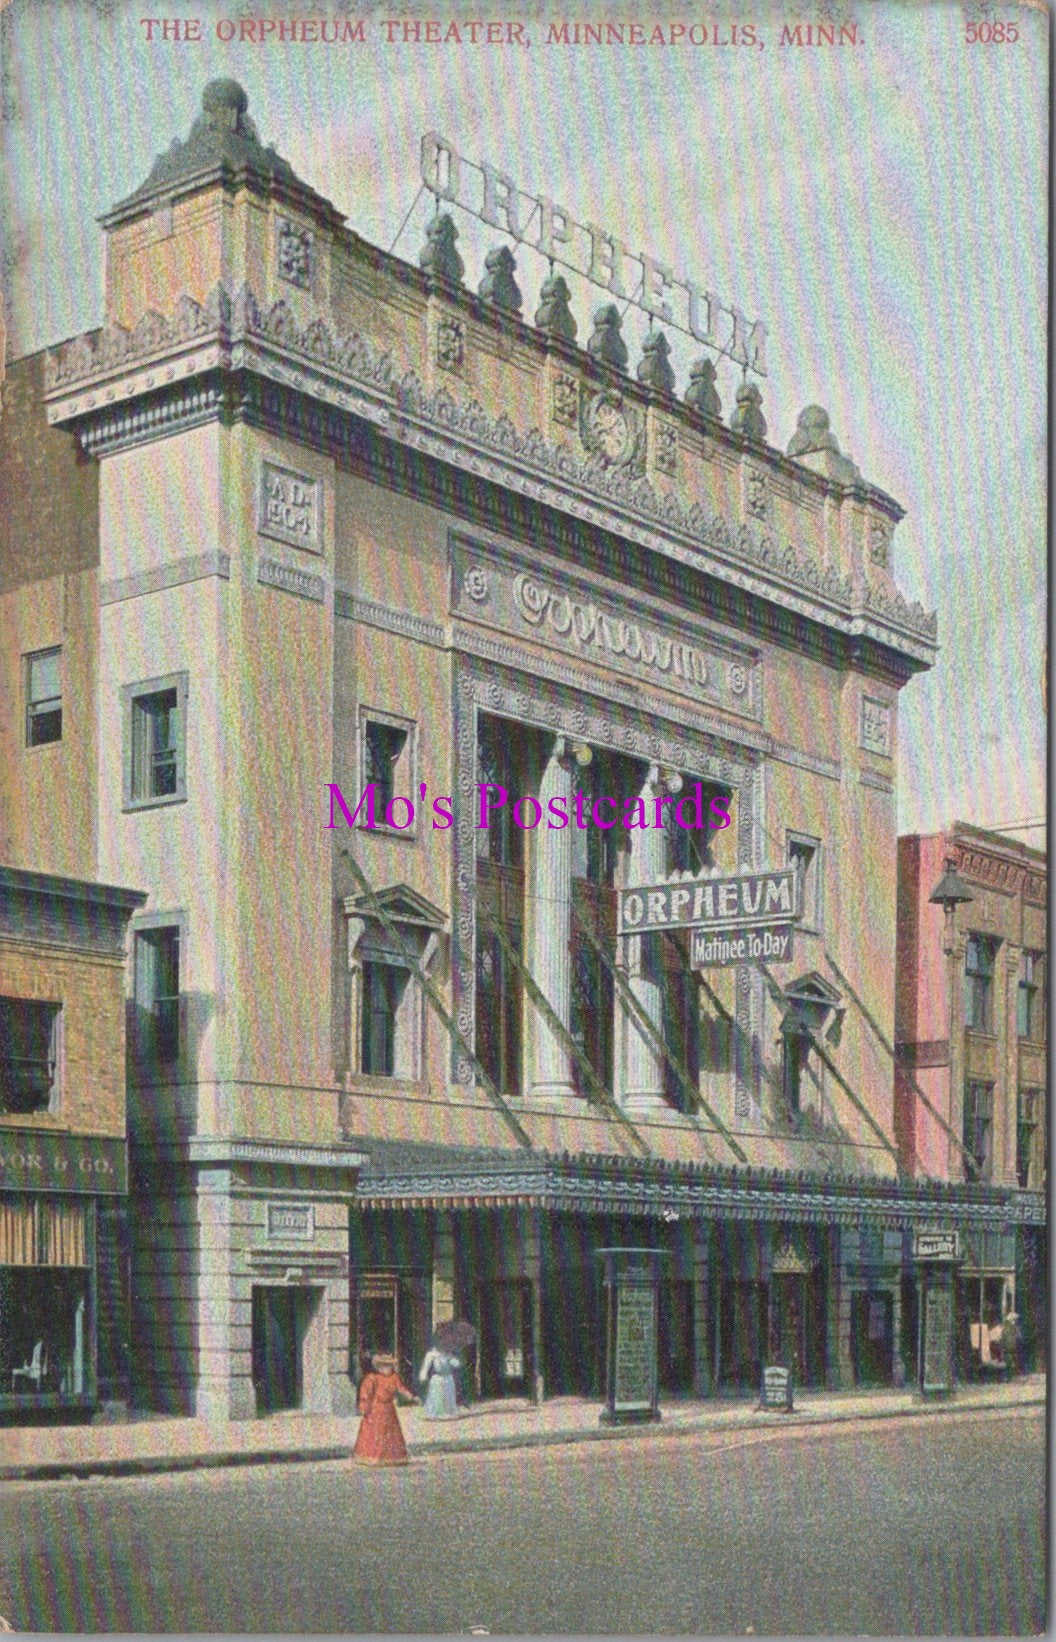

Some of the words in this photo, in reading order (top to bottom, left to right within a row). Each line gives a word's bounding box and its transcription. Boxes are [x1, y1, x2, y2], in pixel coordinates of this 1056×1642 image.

[420, 130, 767, 378] ORPHEUM
[623, 877, 792, 925] ORPHEUM
[694, 935, 745, 963] Matinee
